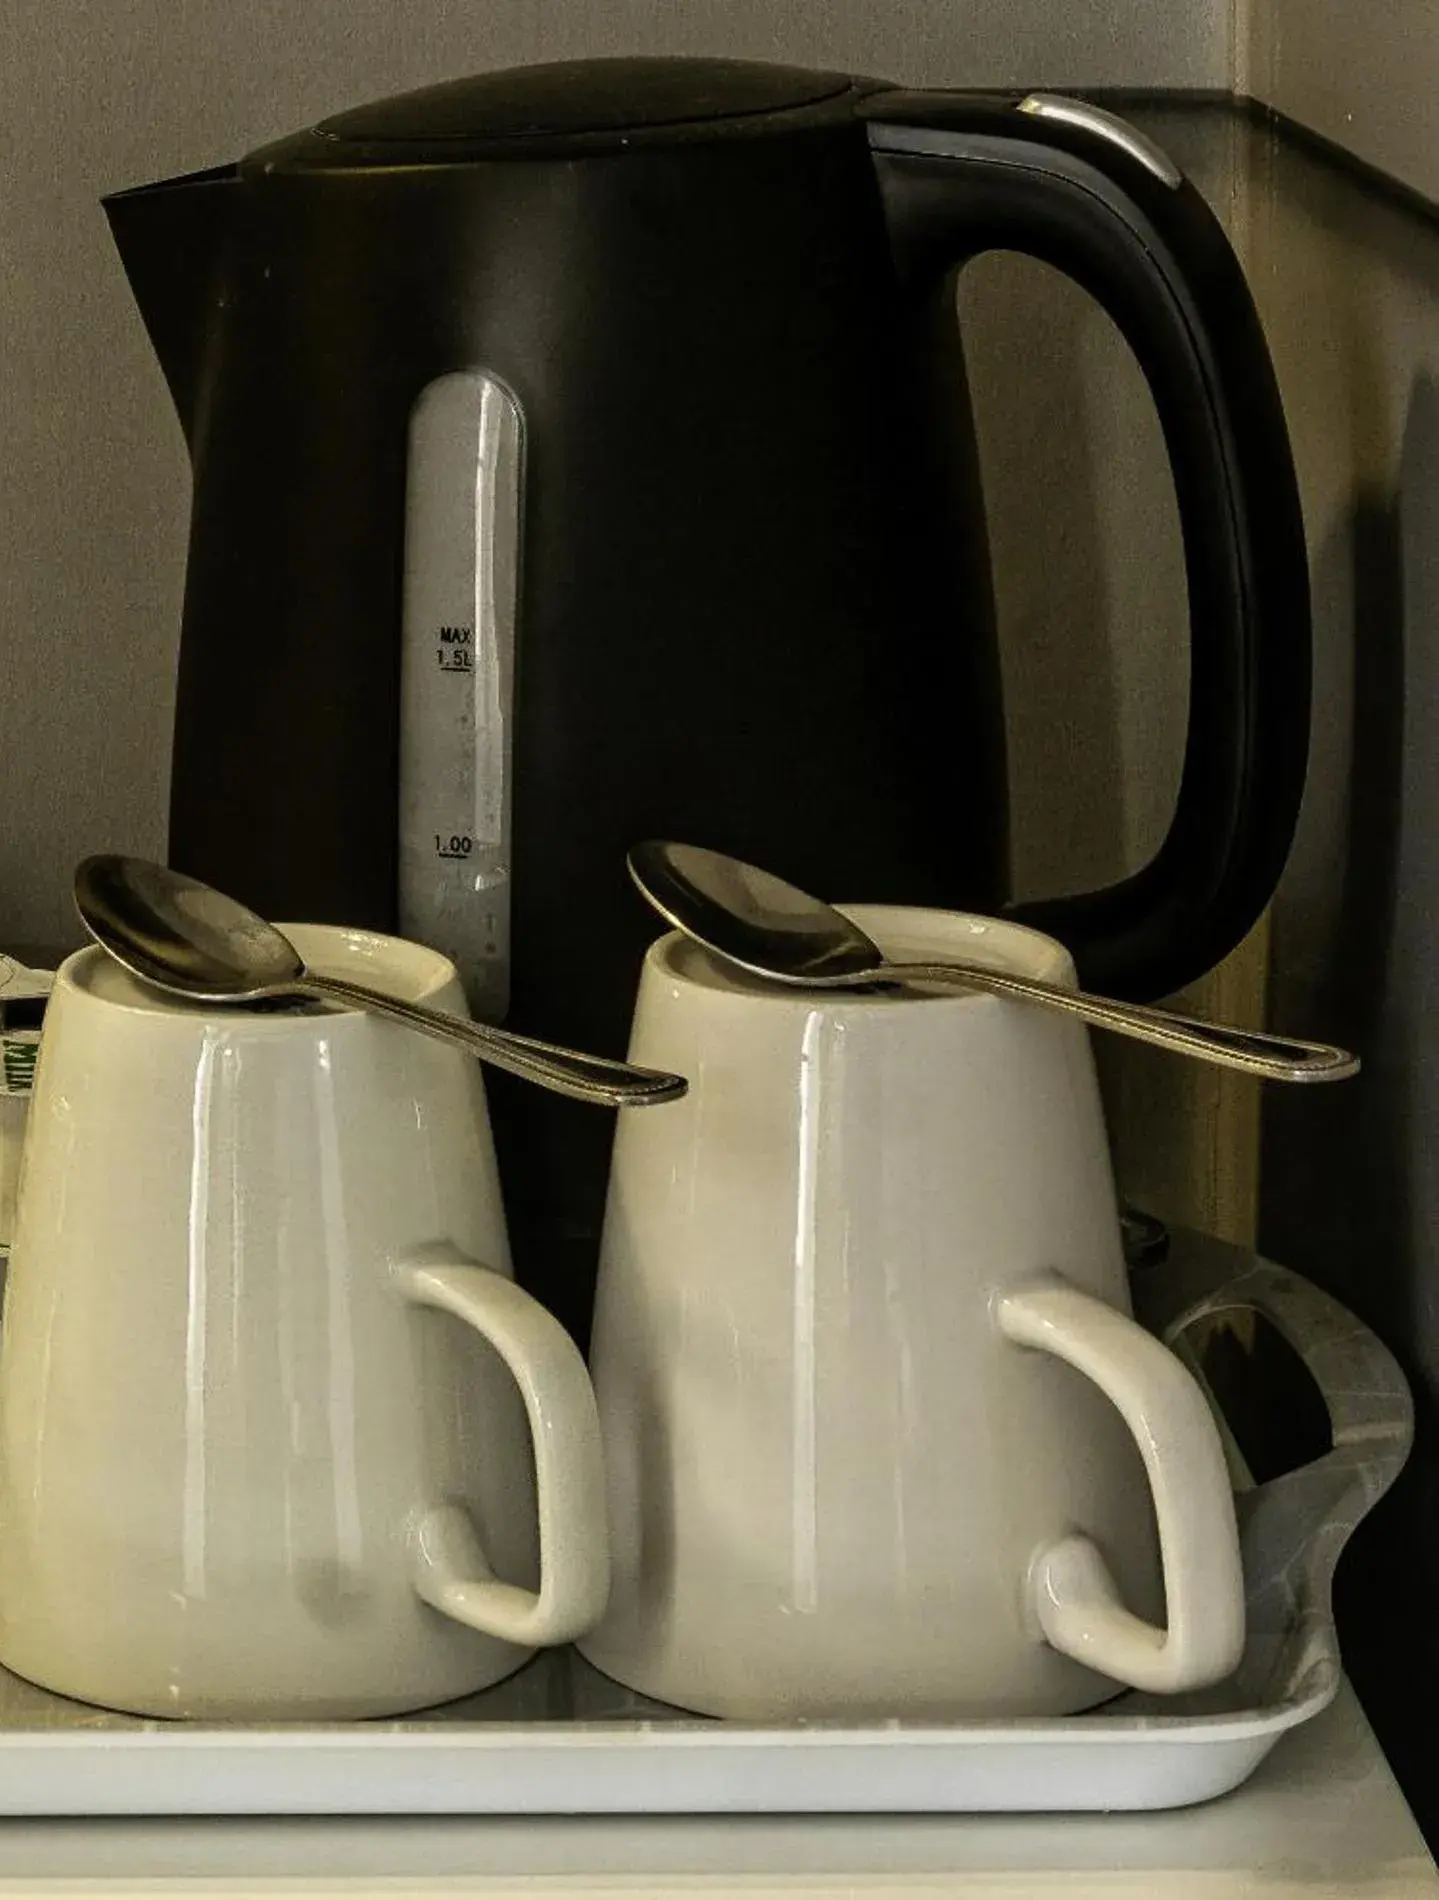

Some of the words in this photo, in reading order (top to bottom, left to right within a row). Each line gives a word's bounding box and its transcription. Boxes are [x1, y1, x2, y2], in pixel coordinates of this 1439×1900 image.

[440, 627, 471, 644] MAX
[436, 650, 472, 666] 1.5L
[434, 834, 472, 853] 1.00
